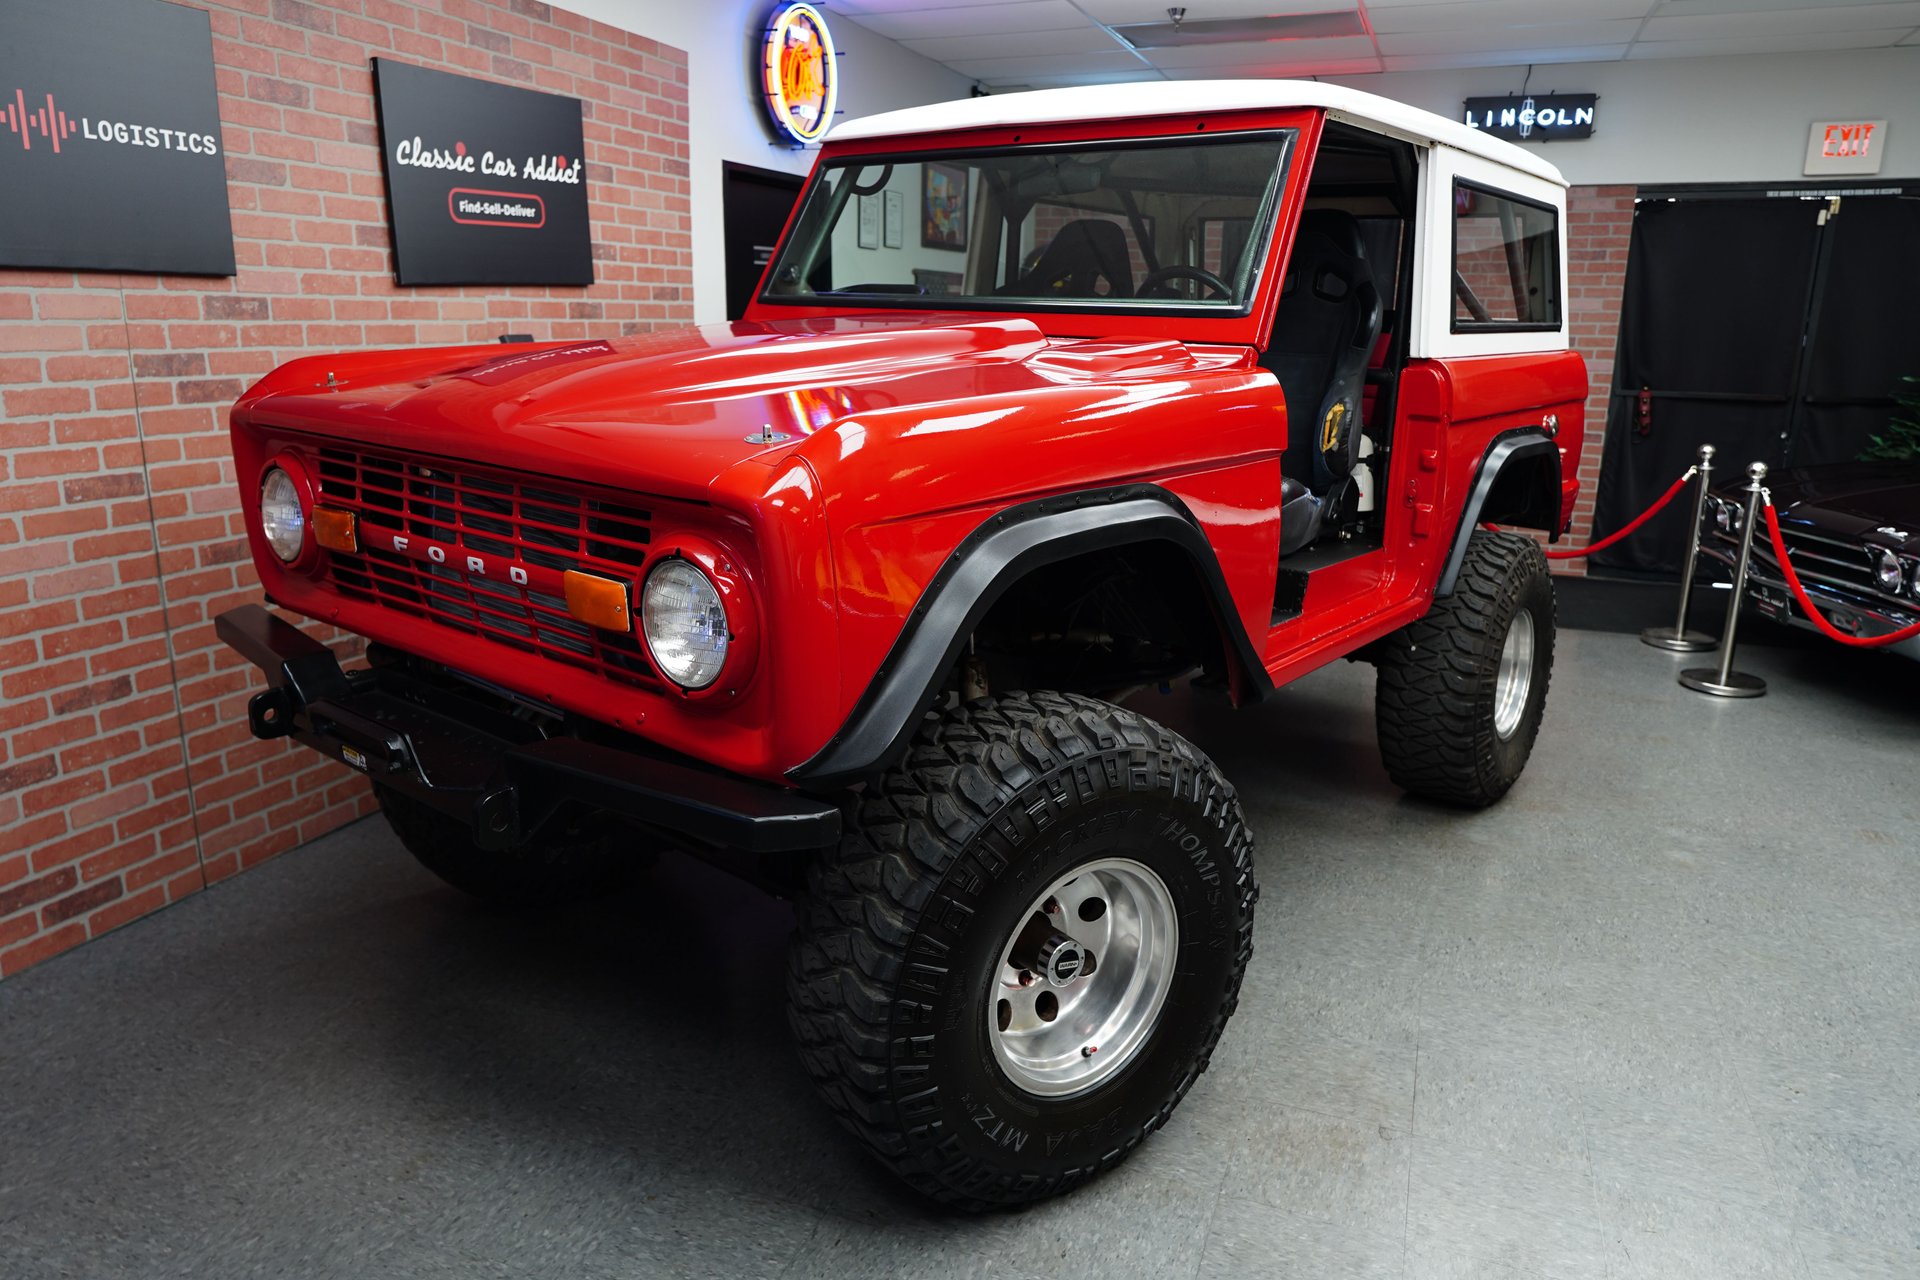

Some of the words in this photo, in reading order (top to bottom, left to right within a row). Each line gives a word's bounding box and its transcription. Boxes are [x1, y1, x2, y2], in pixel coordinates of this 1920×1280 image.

[82, 118, 217, 155] LOGISTICS
[1465, 107, 1594, 128] LINCOLN
[396, 136, 475, 172] Classic
[481, 151, 517, 177] Car
[523, 154, 581, 184] Addict
[1823, 124, 1876, 157] EXIT
[459, 200, 536, 218] Find-Sell-Deliver
[393, 535, 528, 585] FORD
[1156, 812, 1227, 950] THOMPSON
[972, 1104, 1029, 1152] MTZ
